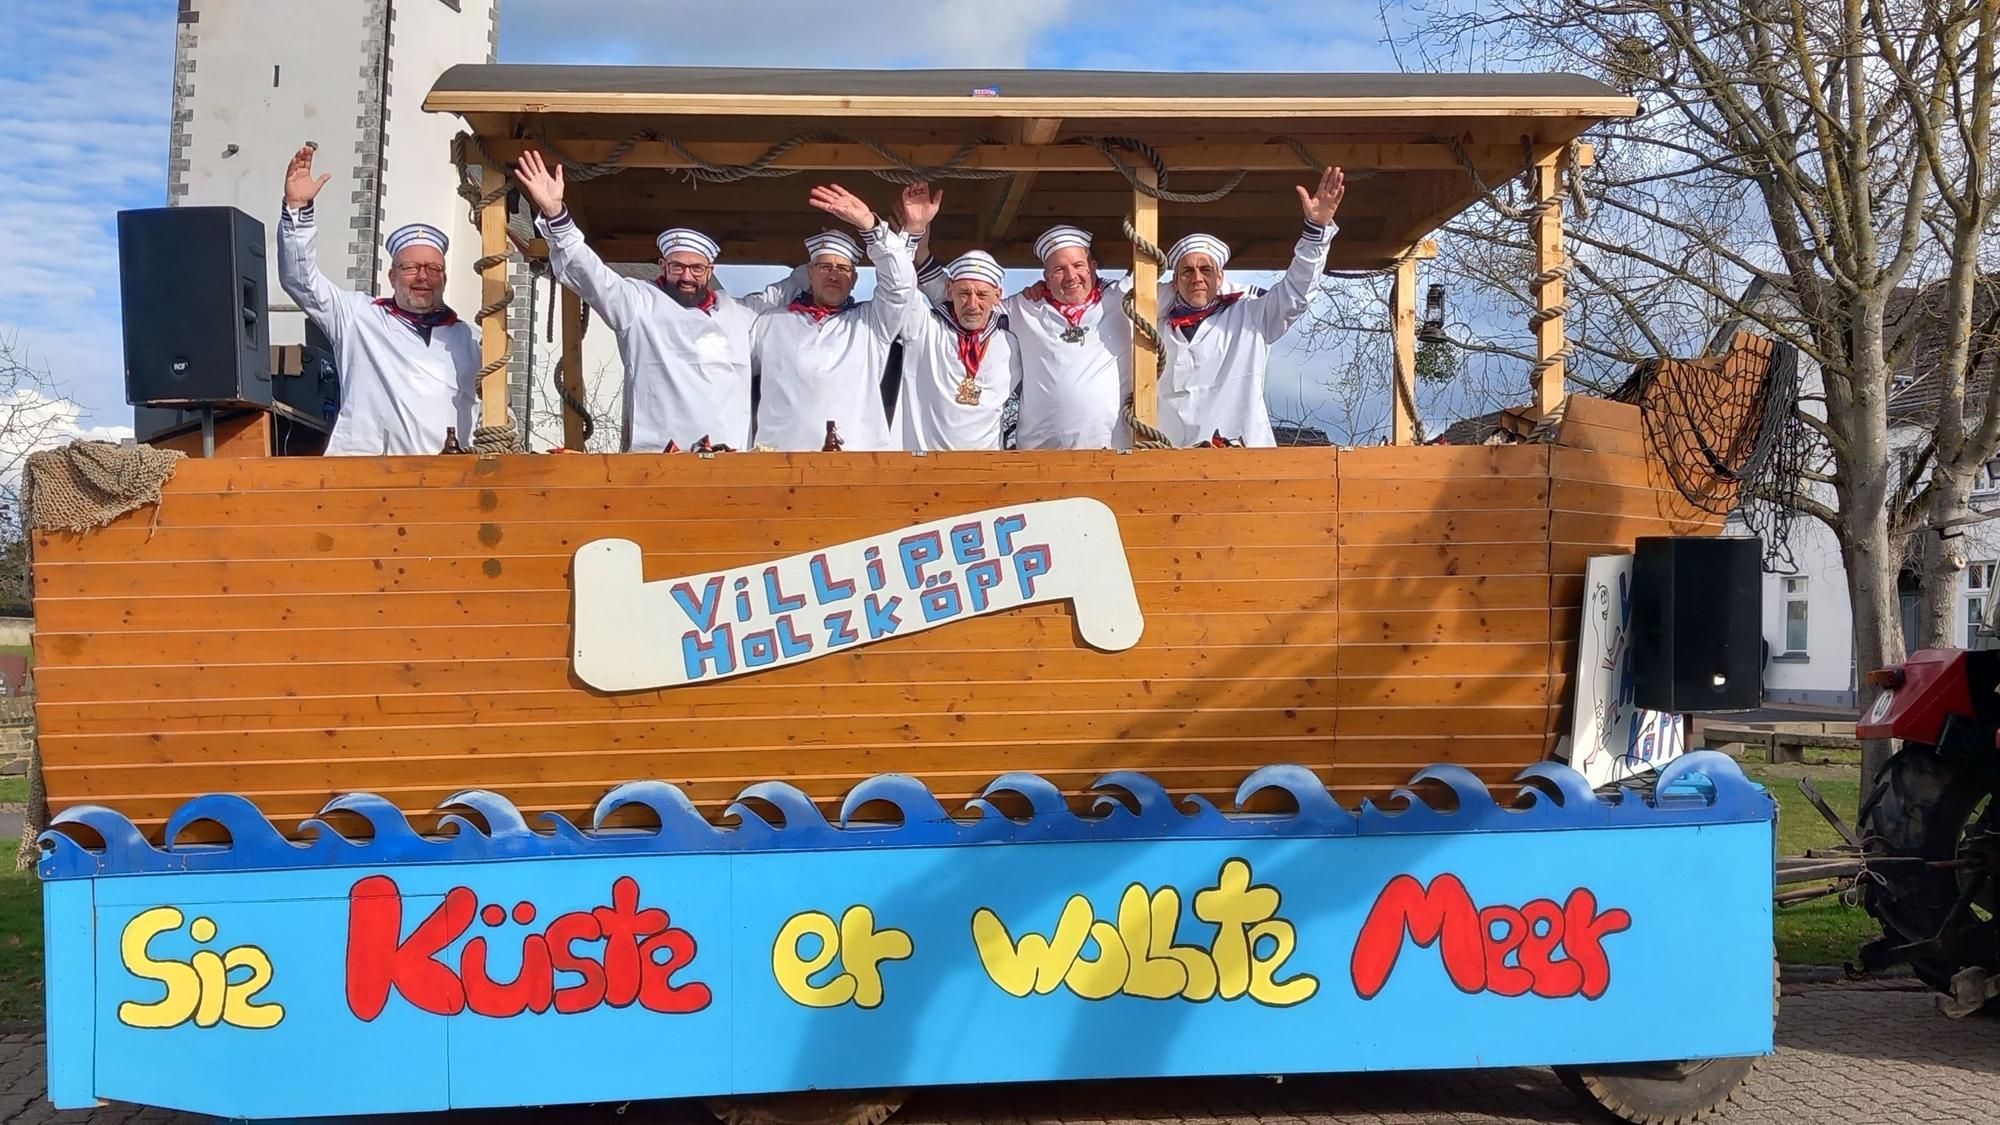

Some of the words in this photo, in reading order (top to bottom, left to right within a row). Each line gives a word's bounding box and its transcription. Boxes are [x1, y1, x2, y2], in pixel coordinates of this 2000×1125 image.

[117, 905, 285, 1029] Sie
[345, 874, 712, 1022] Küste
[771, 903, 915, 1009] er
[1351, 872, 1632, 1001] Meer
